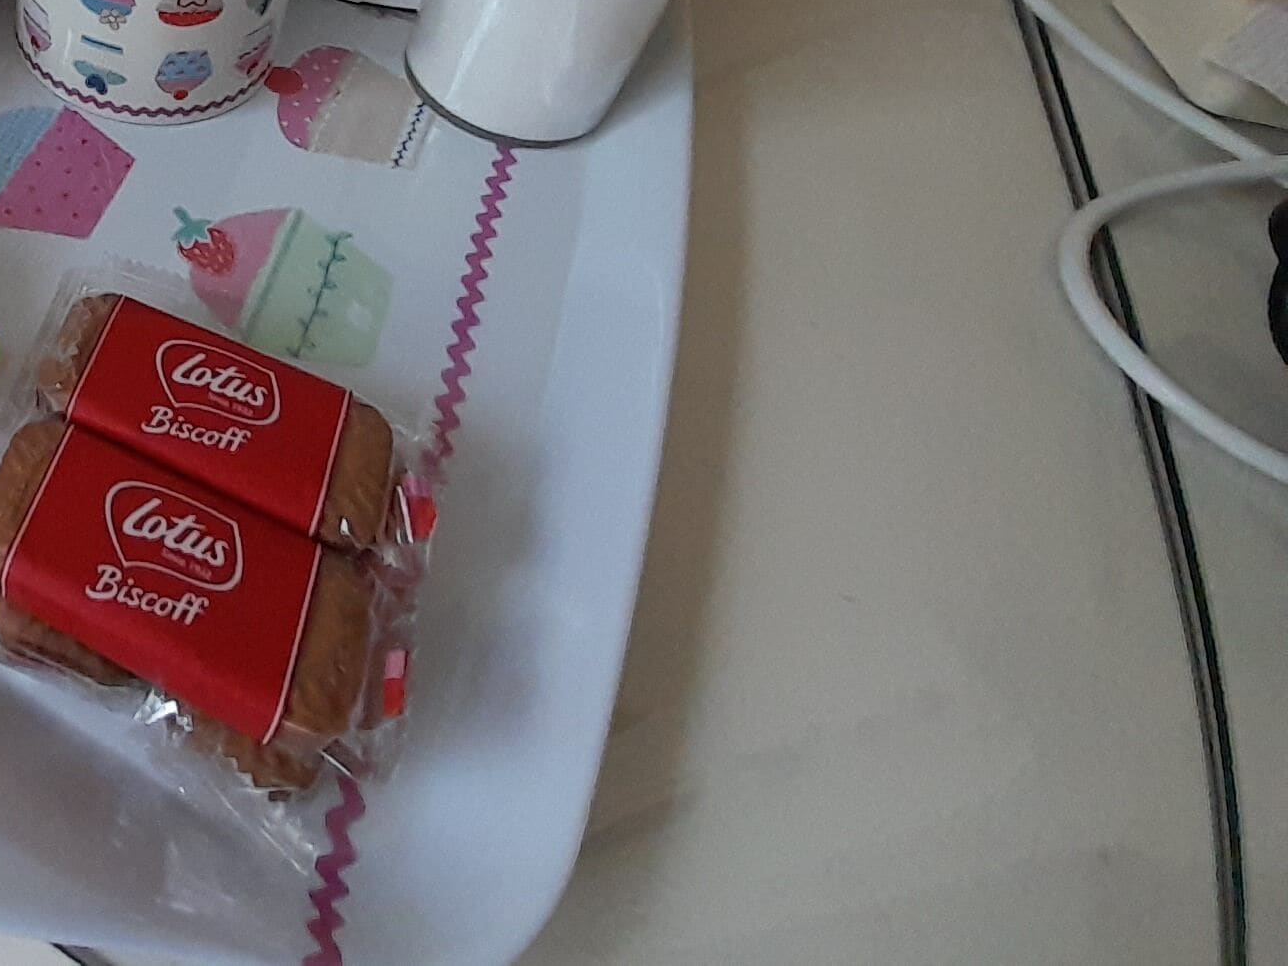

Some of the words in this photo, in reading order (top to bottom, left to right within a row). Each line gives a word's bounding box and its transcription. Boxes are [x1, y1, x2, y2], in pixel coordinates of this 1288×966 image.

[171, 352, 269, 407] Lotus
[140, 405, 252, 452] Biscoff
[122, 497, 230, 567] Lotus
[84, 564, 210, 626] Biscoff
